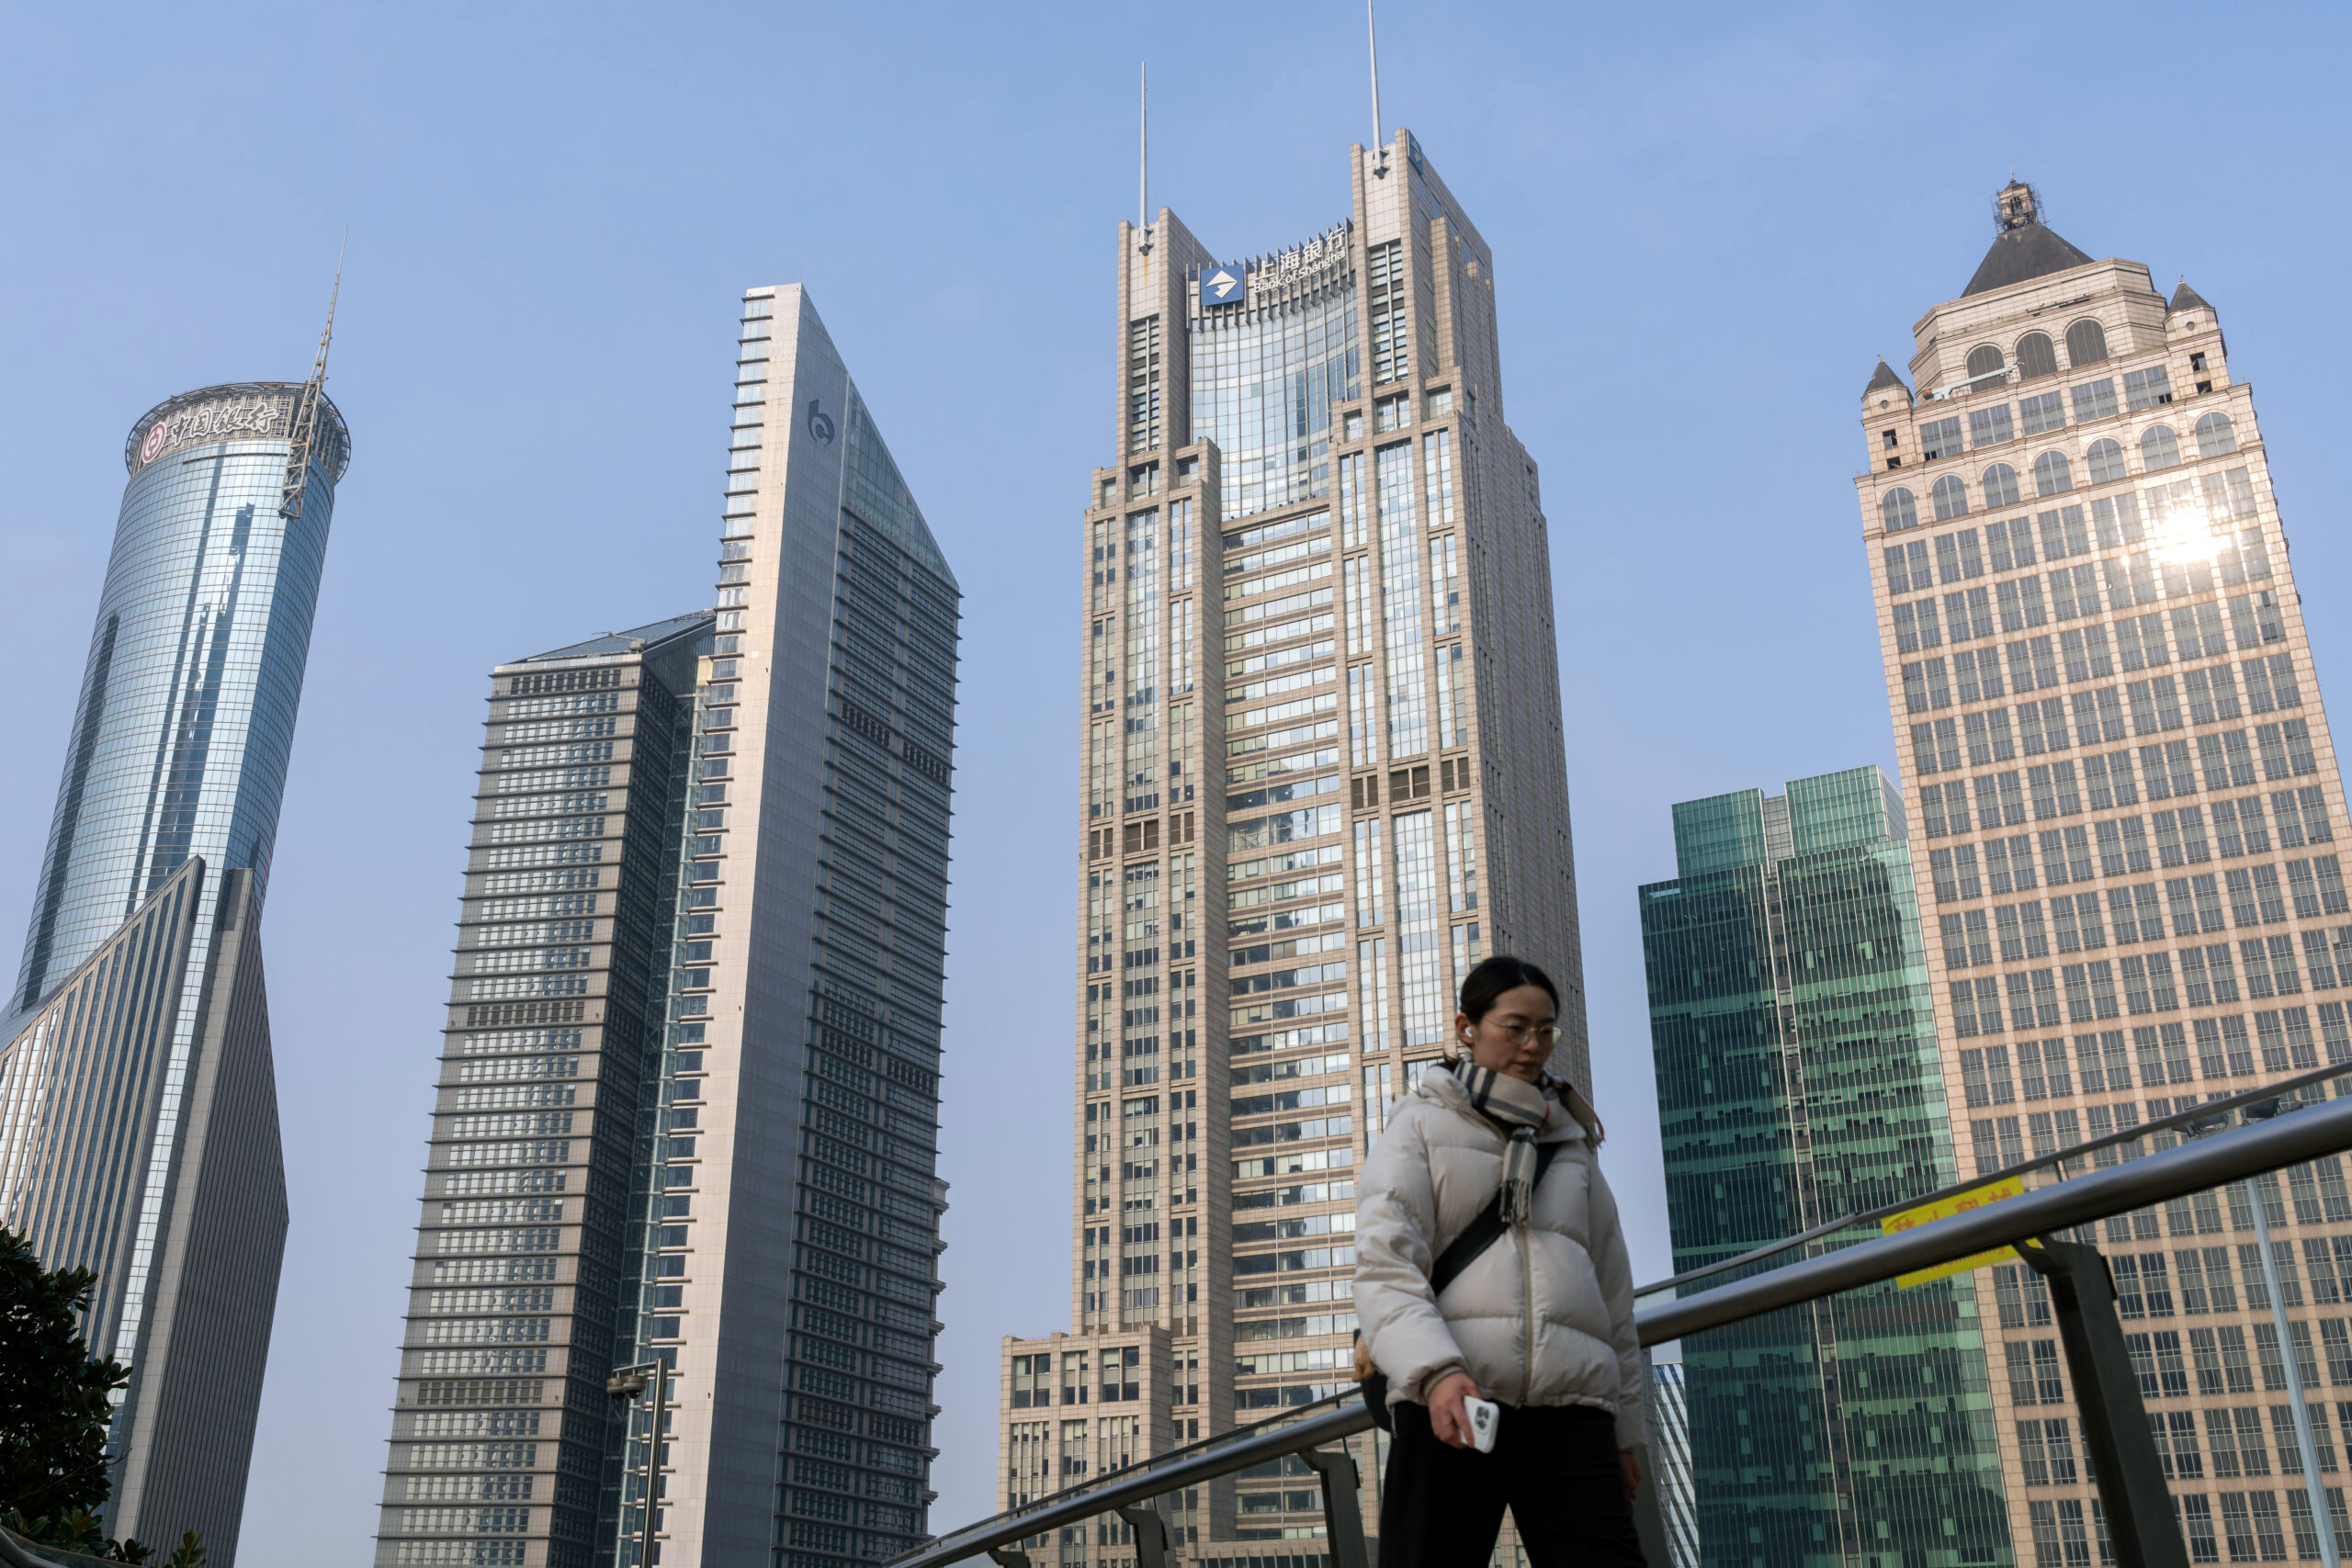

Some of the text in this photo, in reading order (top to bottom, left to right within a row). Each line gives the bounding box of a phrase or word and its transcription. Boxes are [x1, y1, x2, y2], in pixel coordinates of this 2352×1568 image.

[1253, 246, 1346, 294] Bank of Shanghai
[1254, 227, 1345, 282] 上海银行
[171, 401, 279, 446] 中国银行
